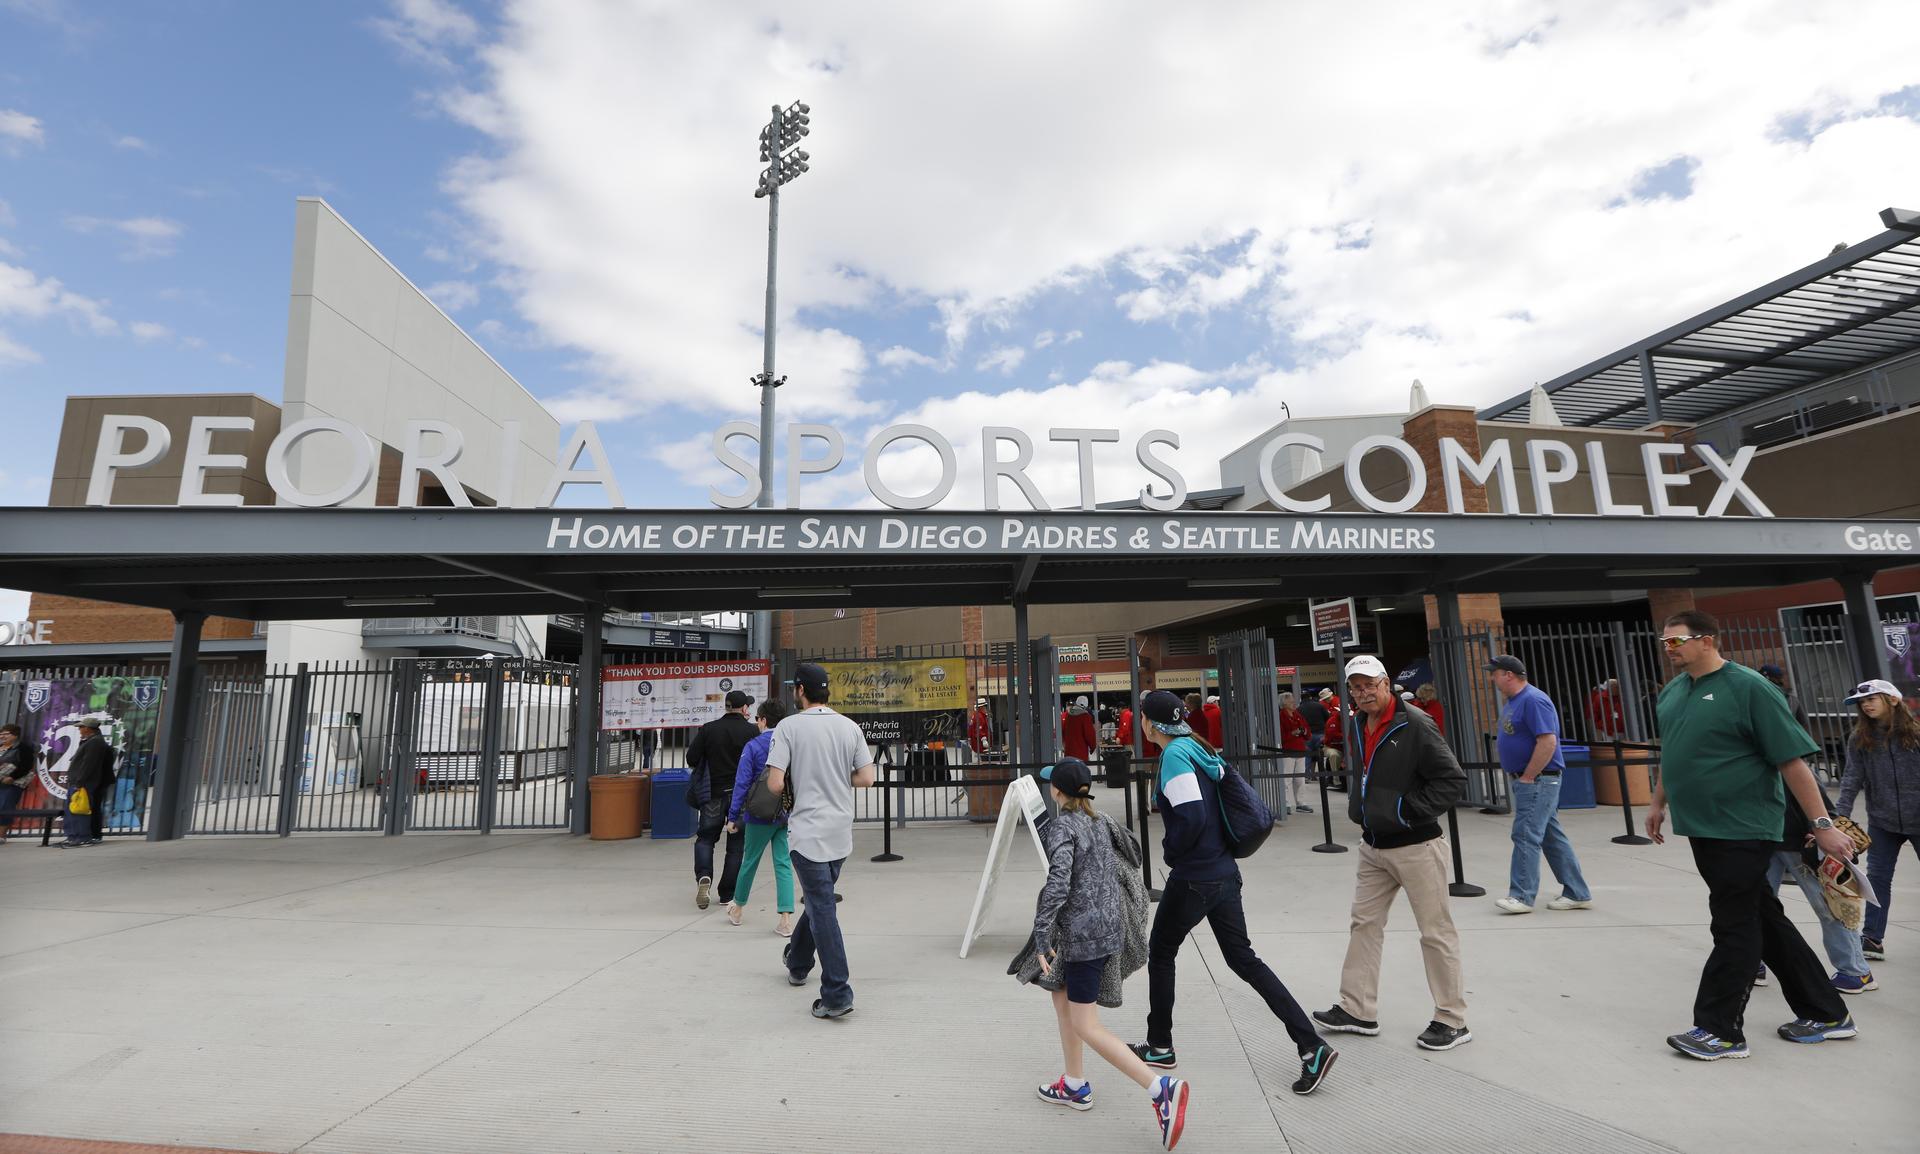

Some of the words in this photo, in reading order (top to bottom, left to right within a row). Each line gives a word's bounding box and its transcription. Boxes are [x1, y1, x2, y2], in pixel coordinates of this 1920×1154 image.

[86, 414, 626, 509] PEORIA
[710, 421, 1187, 511] SPORTS
[1258, 432, 1775, 518] COMPLEX
[546, 517, 661, 549] HOME
[671, 524, 717, 549] OF
[720, 524, 785, 549] THE
[797, 518, 867, 549] SAN
[877, 518, 988, 550] DIEGO
[1001, 519, 1118, 550] PADRES
[1128, 526, 1151, 550] &
[1162, 520, 1281, 550] SEATTLE
[1290, 520, 1436, 551] MARINERS
[1844, 525, 1913, 551] Gate
[646, 667, 666, 676] YOU
[668, 666, 681, 675] TO
[683, 665, 705, 674] OUR
[872, 720, 900, 730] Peoria
[866, 730, 901, 740] Realtors
